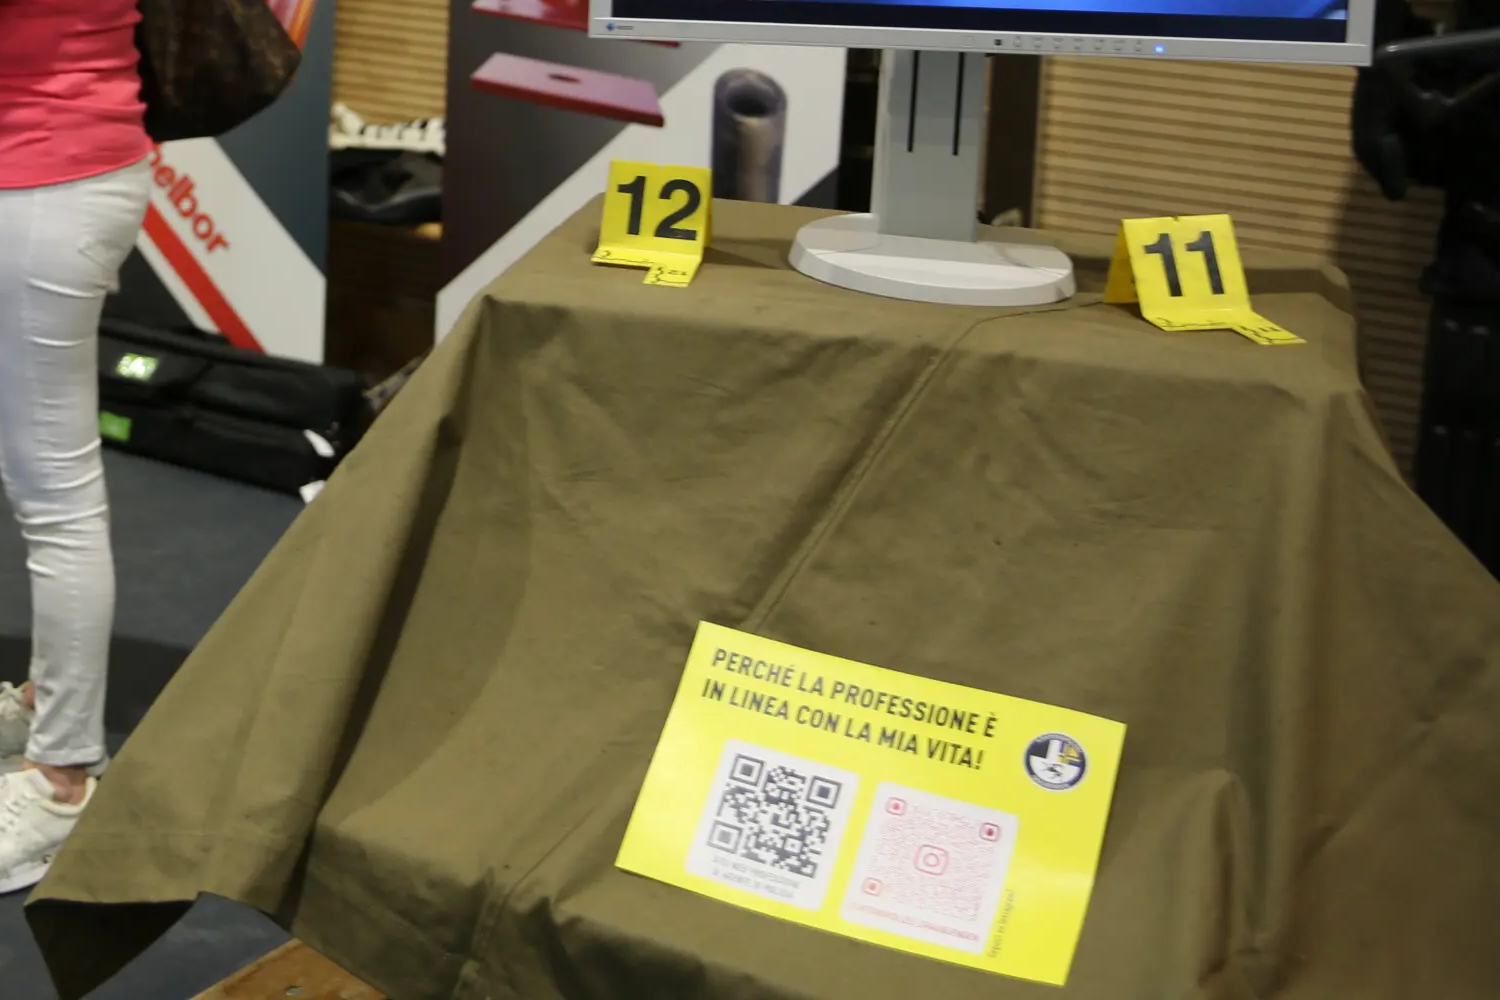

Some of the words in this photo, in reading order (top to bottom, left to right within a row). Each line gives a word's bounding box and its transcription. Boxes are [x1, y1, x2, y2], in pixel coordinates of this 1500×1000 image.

[617, 174, 702, 241] 12
[1143, 230, 1225, 298] 11
[702, 678, 726, 702] IN
[729, 686, 790, 721] LINEA
[796, 704, 841, 734] CON
[844, 716, 871, 744] LA
[878, 726, 919, 755] MIA
[926, 737, 986, 770] VITA!
[712, 647, 795, 687] PERCHÉ
[797, 671, 824, 697] LA
[830, 680, 980, 735] PROFESSIONE
[983, 711, 998, 738] È
